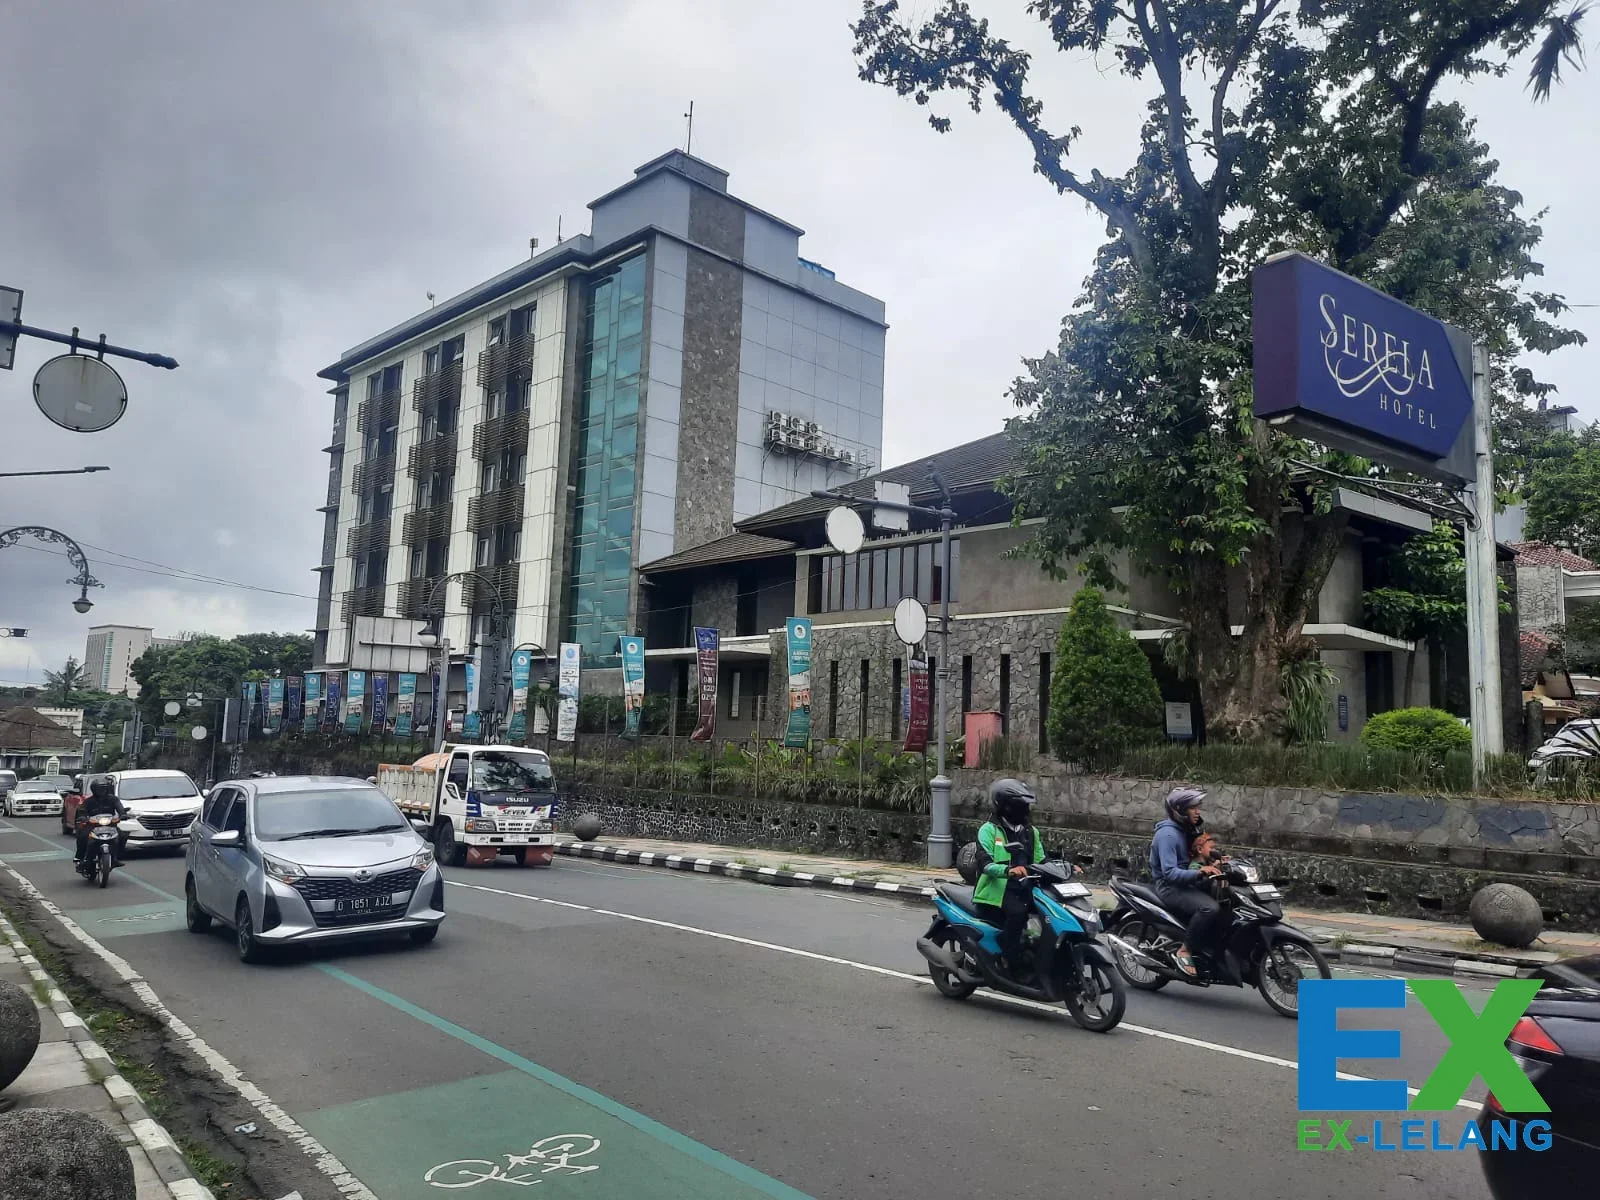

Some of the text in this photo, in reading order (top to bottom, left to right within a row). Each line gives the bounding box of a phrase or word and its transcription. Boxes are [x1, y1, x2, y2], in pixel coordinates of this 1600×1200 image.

[1319, 294, 1435, 396] SERELA
[1380, 394, 1437, 430] HOTEL
[350, 898, 369, 909] 1851
[375, 896, 390, 906] AJZ
